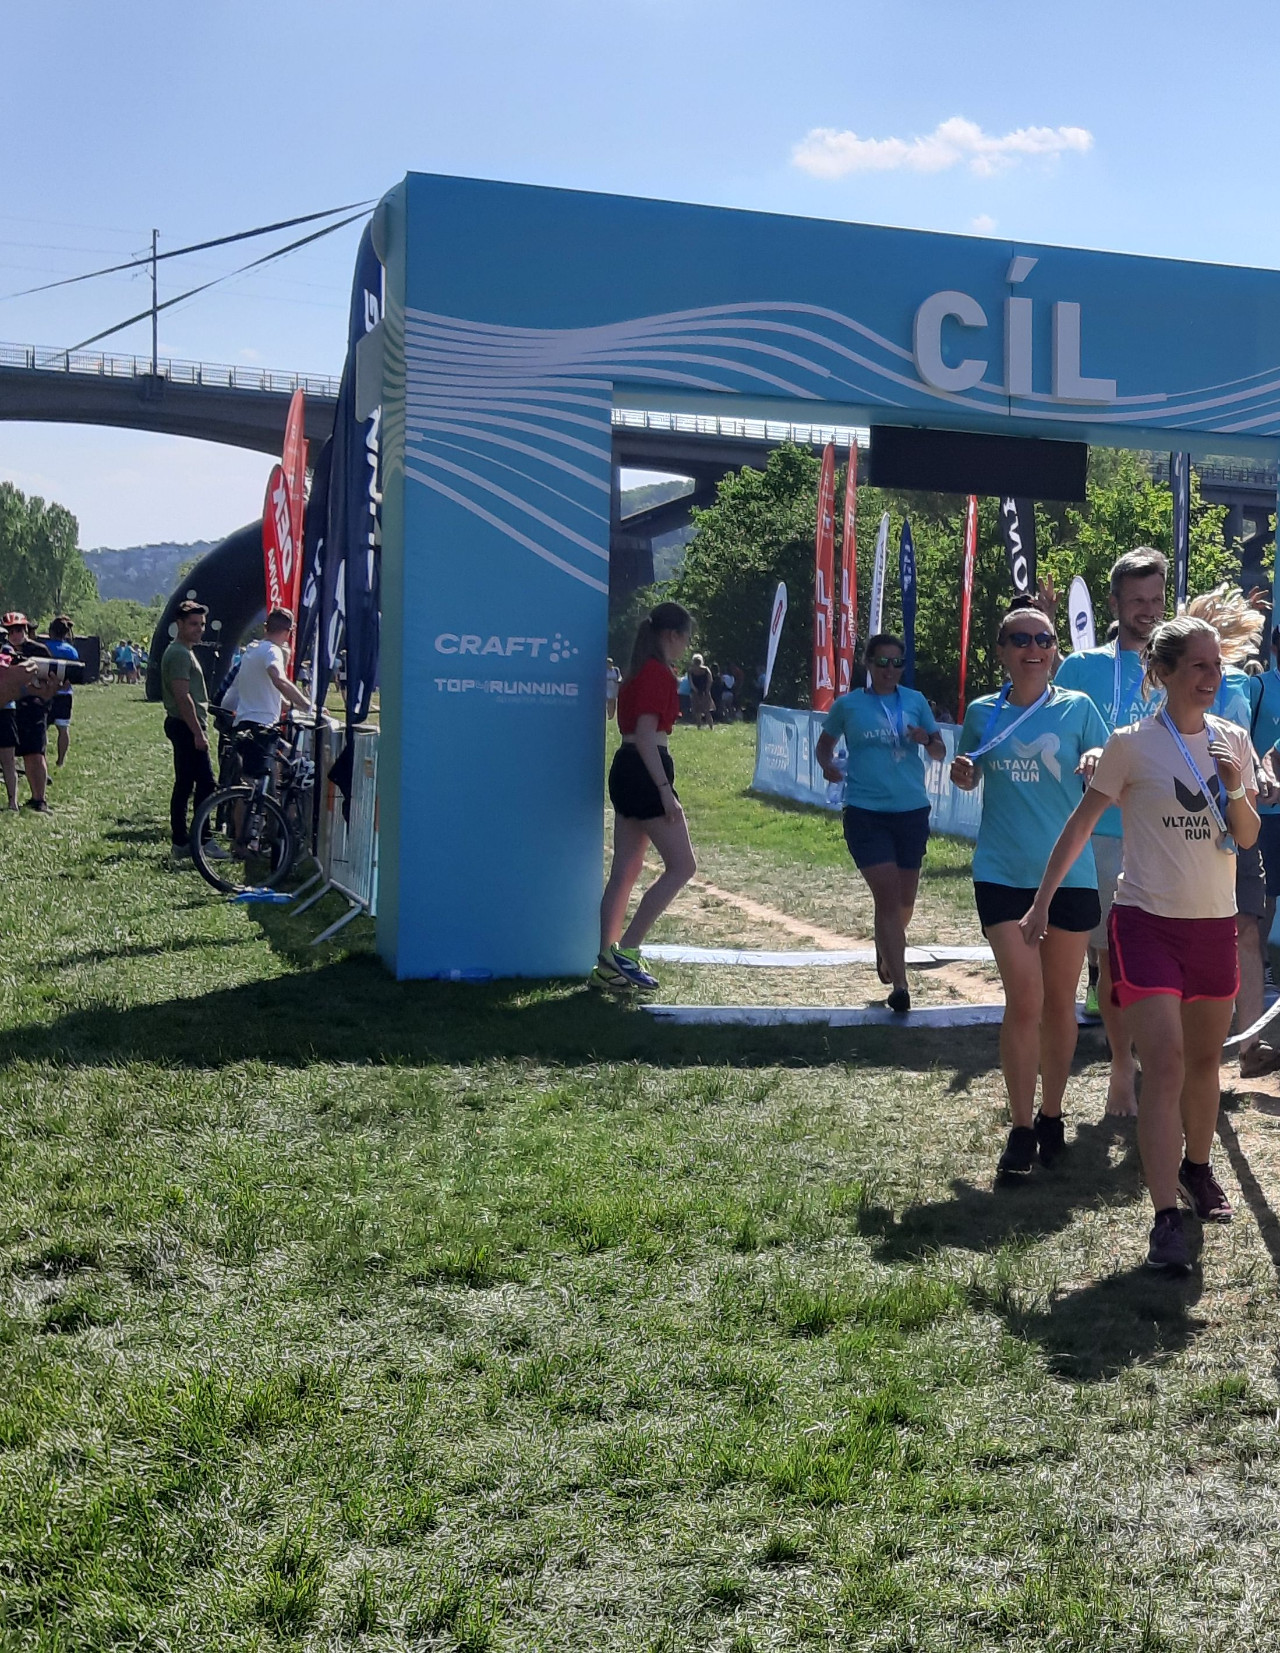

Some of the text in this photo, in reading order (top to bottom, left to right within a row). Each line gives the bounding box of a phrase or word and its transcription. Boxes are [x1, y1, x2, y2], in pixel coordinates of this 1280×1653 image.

[913, 255, 1117, 401] CÍL
[434, 633, 548, 657] CRAFT
[434, 678, 579, 696] TOP4RUNNING
[1102, 702, 1157, 714] VAVA
[989, 759, 1040, 771] VLTAVA
[1011, 771, 1040, 783] RUN
[1162, 816, 1210, 828] VLTAVA
[1185, 828, 1211, 840] RUN
